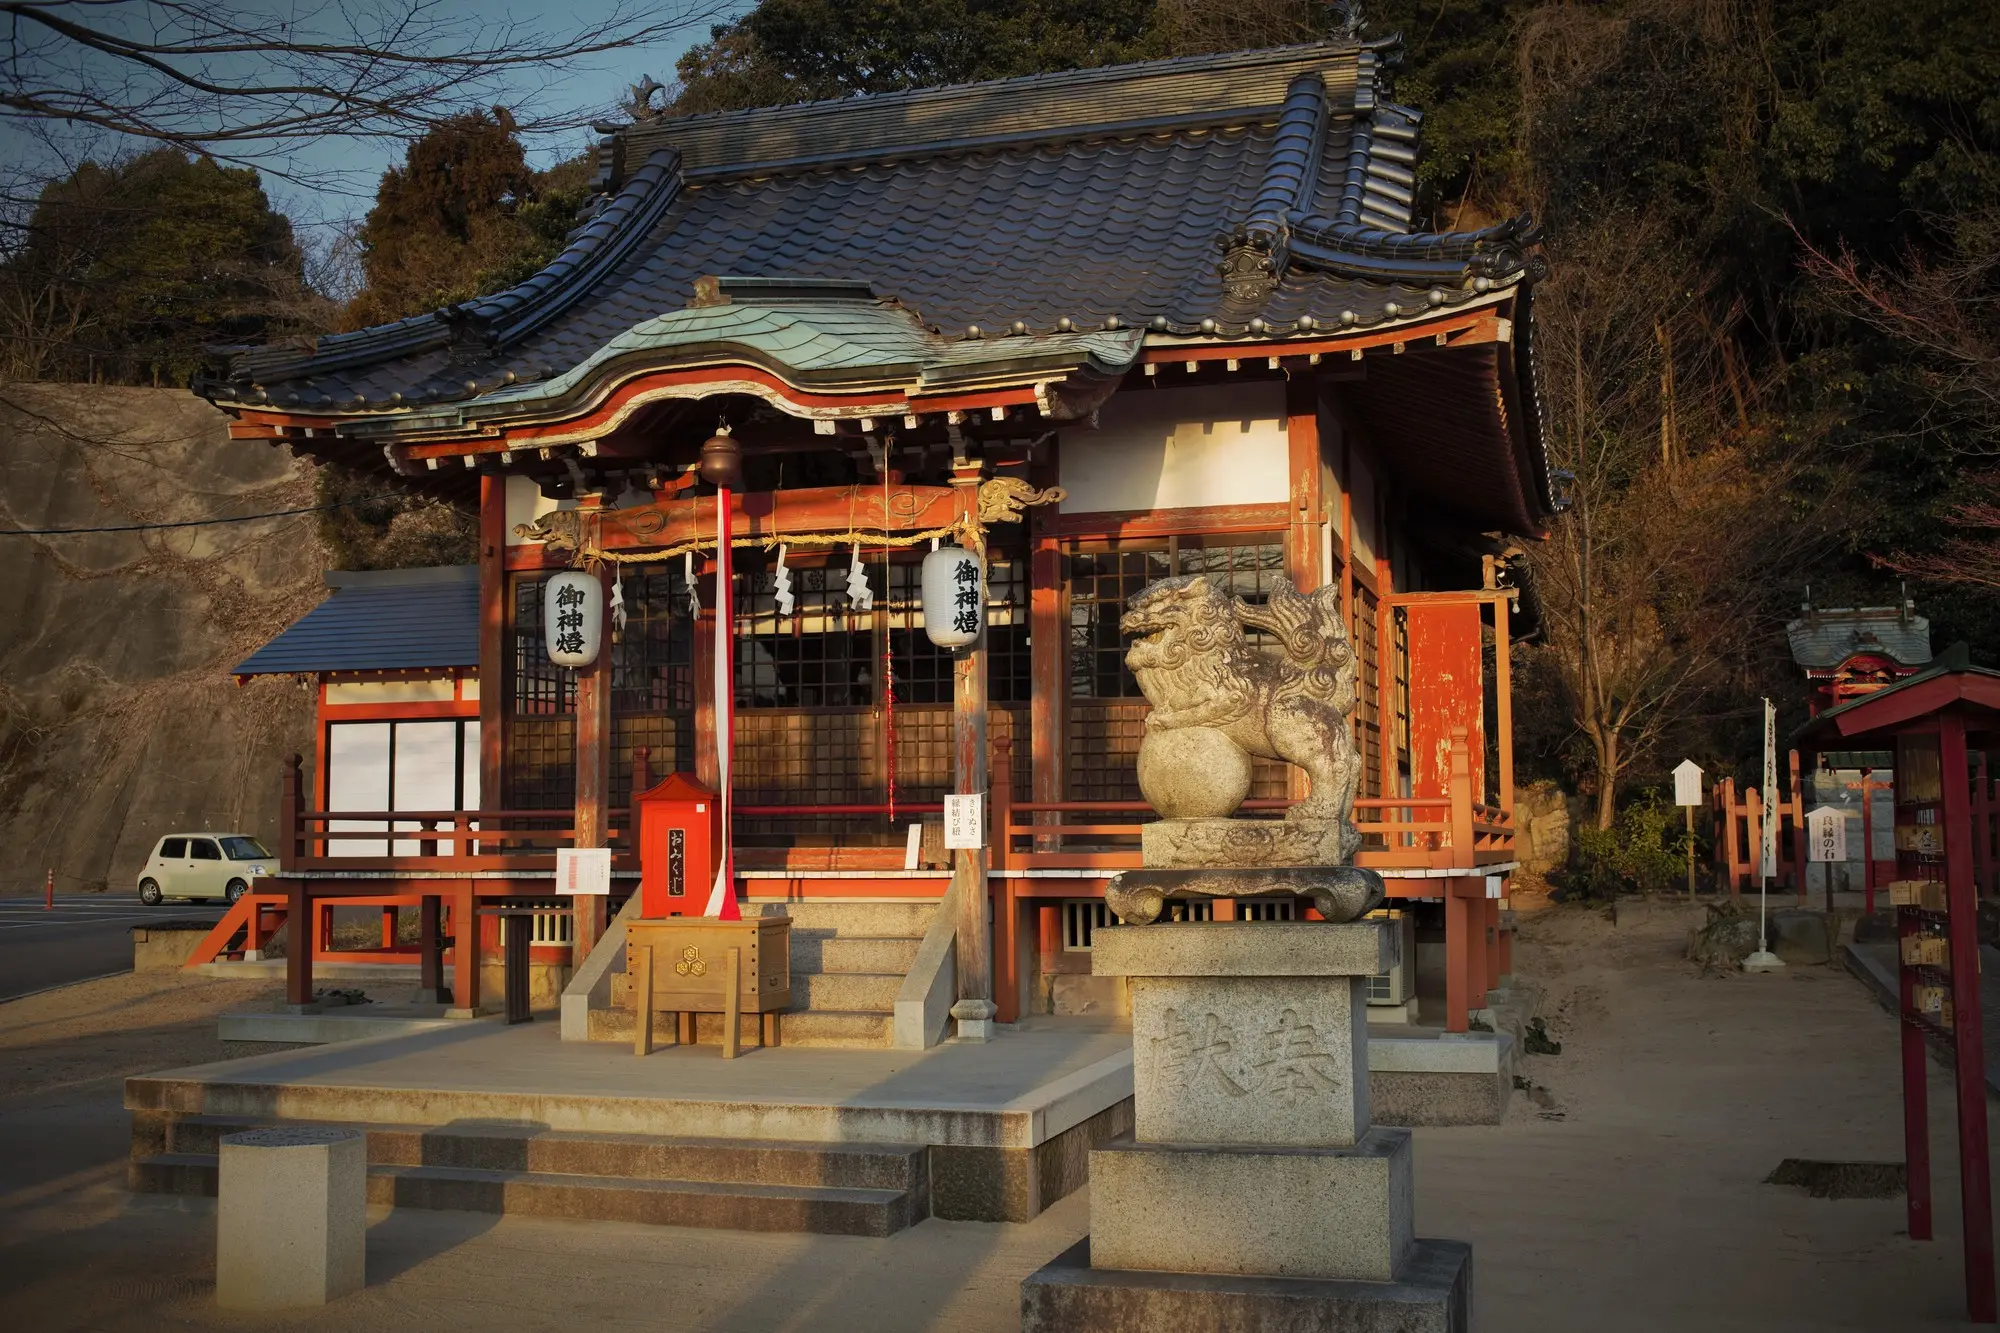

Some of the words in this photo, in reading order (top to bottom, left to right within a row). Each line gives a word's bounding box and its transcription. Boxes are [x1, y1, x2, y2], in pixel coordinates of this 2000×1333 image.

[555, 583, 586, 655] 御神燈
[953, 559, 979, 634] 御神燈
[669, 831, 683, 894] おみくじ
